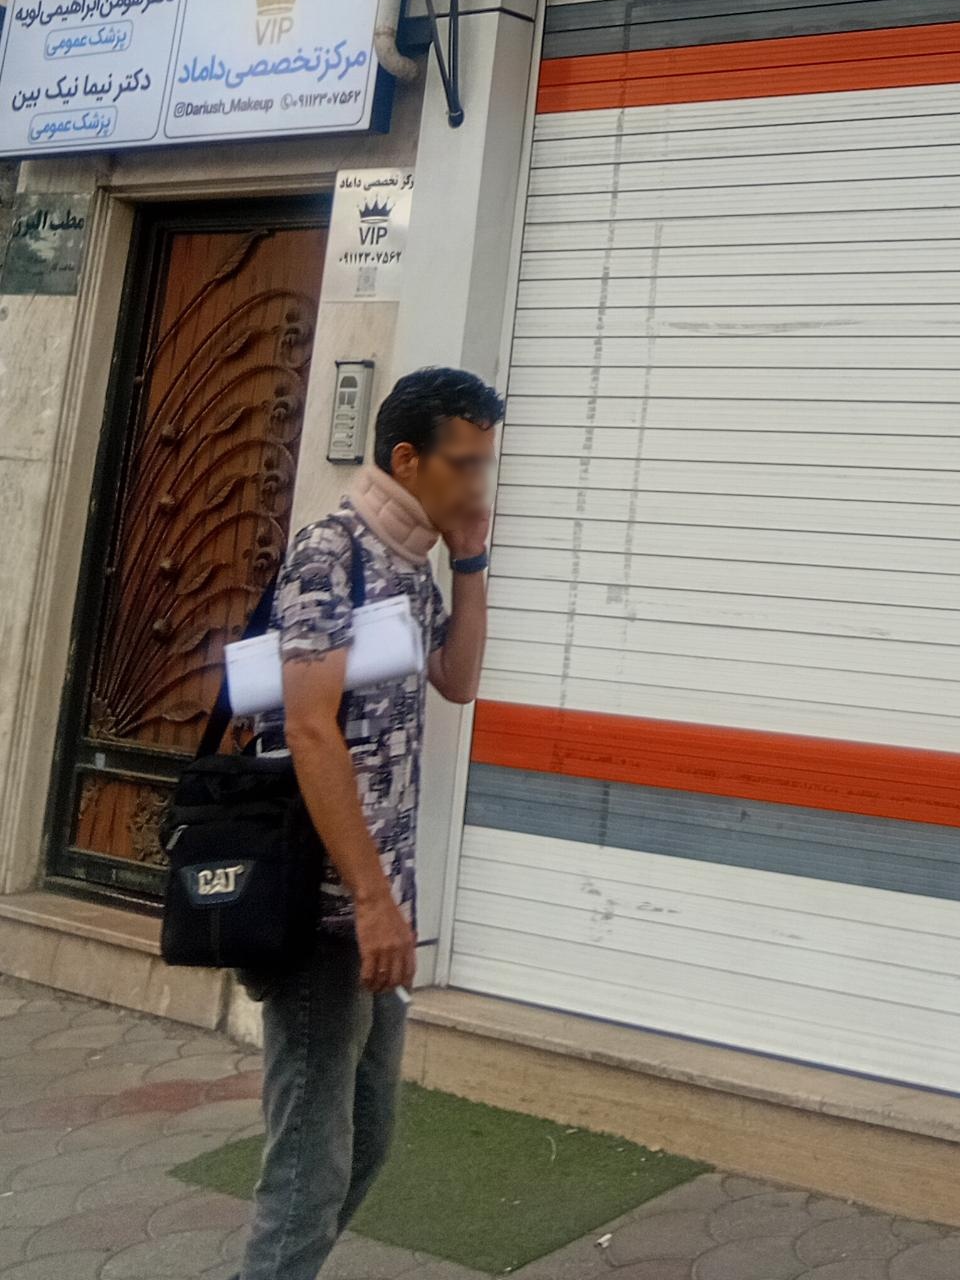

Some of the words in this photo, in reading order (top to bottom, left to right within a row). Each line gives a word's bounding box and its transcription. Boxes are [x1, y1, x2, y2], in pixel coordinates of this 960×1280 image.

[89, 27, 127, 50] پزشک
[255, 16, 295, 46] VIP
[46, 36, 88, 56] عمومی
[178, 54, 225, 85] داماد
[225, 48, 322, 89] تخصصی
[316, 39, 368, 82] مرکز
[45, 75, 78, 105] نیک
[83, 73, 112, 102] نیما
[113, 68, 151, 103] دکتر
[12, 87, 41, 112] بین
[29, 121, 71, 140] عمومی
[72, 112, 111, 135] پزشک
[339, 176, 362, 189] داماد
[363, 174, 399, 191] تخصصی
[400, 173, 415, 191] رکز
[49, 209, 84, 236] مطب
[358, 226, 388, 246] VIP
[198, 865, 244, 895] CAT
